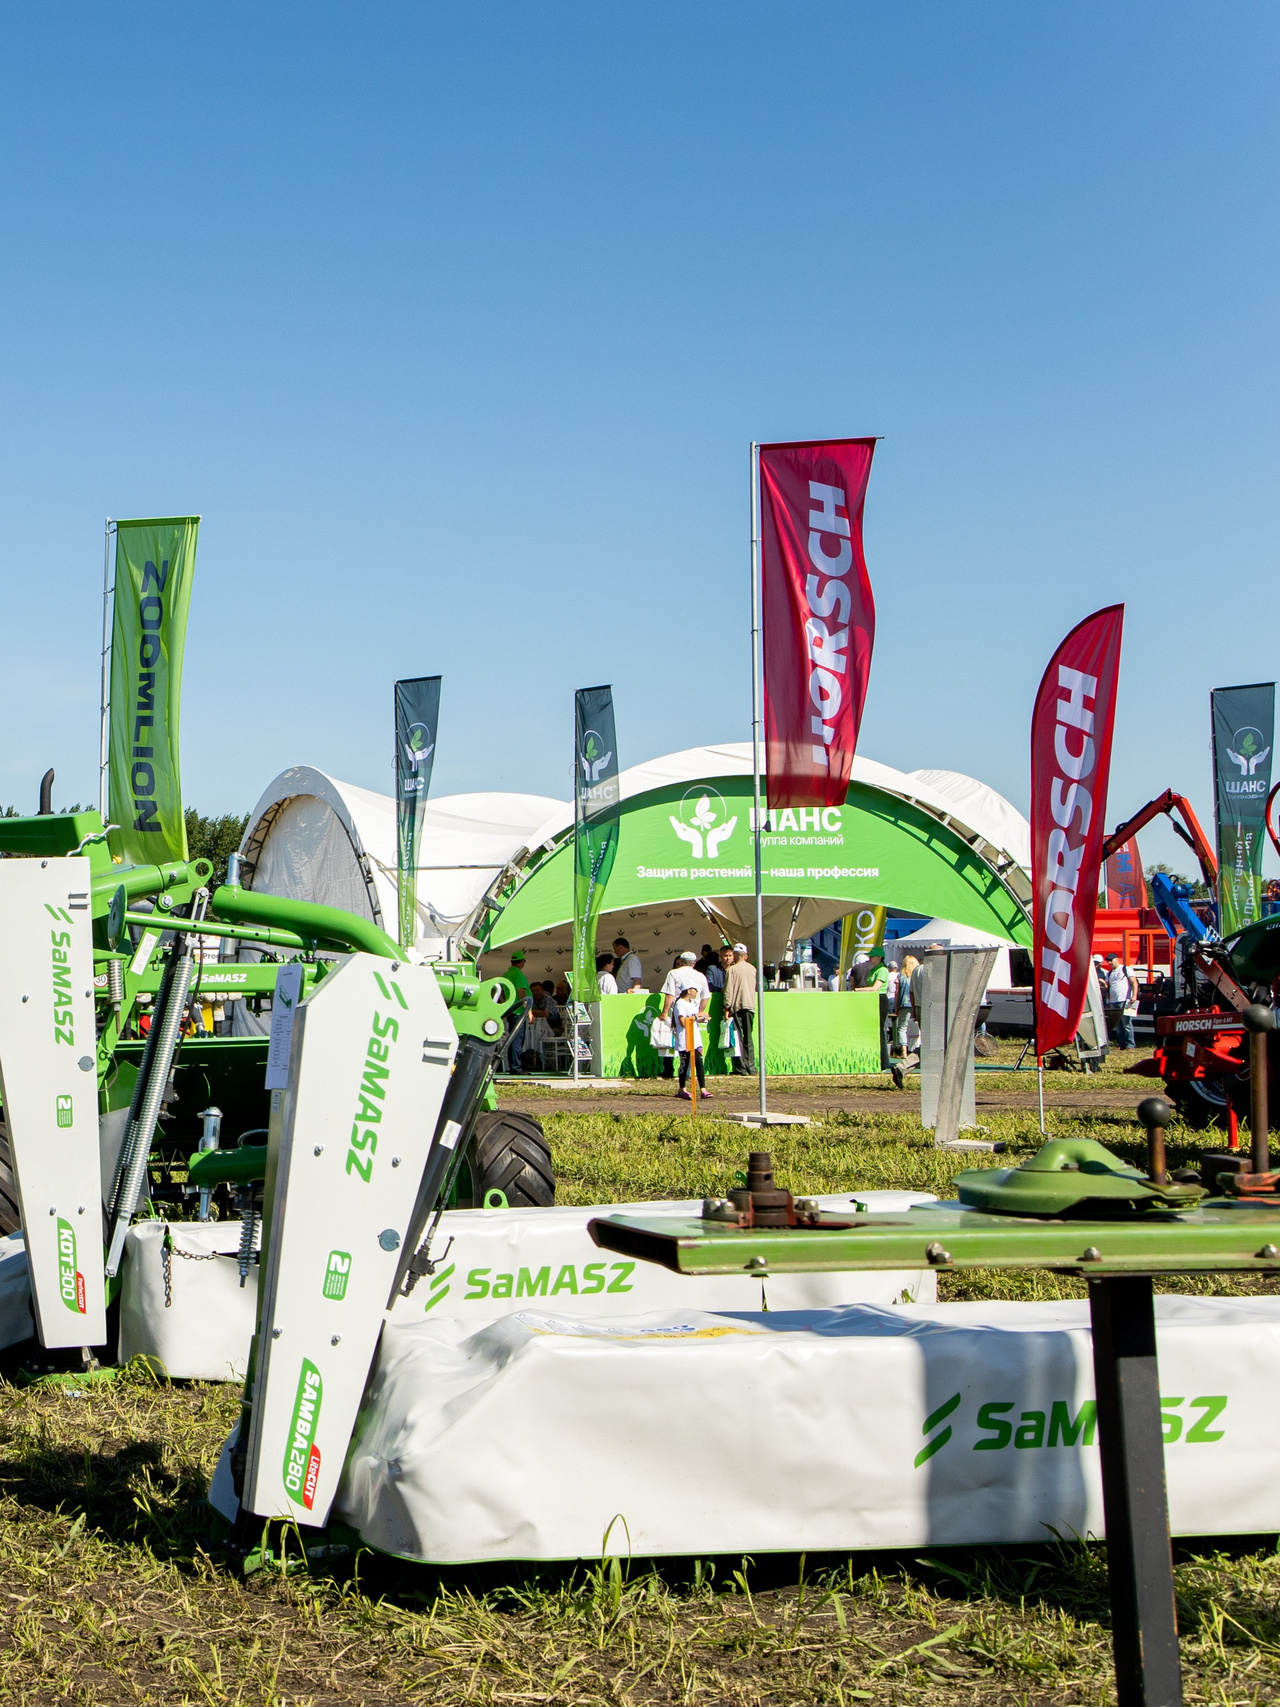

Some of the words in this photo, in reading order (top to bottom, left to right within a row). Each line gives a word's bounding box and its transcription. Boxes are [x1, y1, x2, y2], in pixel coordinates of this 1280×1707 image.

[131, 559, 169, 833] ZOOMLION
[1225, 780, 1266, 793] ШАНС
[789, 834, 844, 845] компаний
[1040, 664, 1099, 1020] HORSCH
[636, 866, 688, 879] Защита
[690, 865, 752, 879] растений
[770, 868, 805, 877] наша
[807, 867, 879, 880] профессия
[50, 931, 76, 1047] SaMASZ
[95, 975, 106, 983] 30
[201, 973, 248, 983] SaMASZ
[1175, 1019, 1213, 1031] HORSCH
[345, 1010, 399, 1184] SaMASZ
[464, 1261, 635, 1300] SaMASZ
[973, 1395, 1228, 1450] SaMSZ
[304, 1455, 320, 1499] LiteCUT
